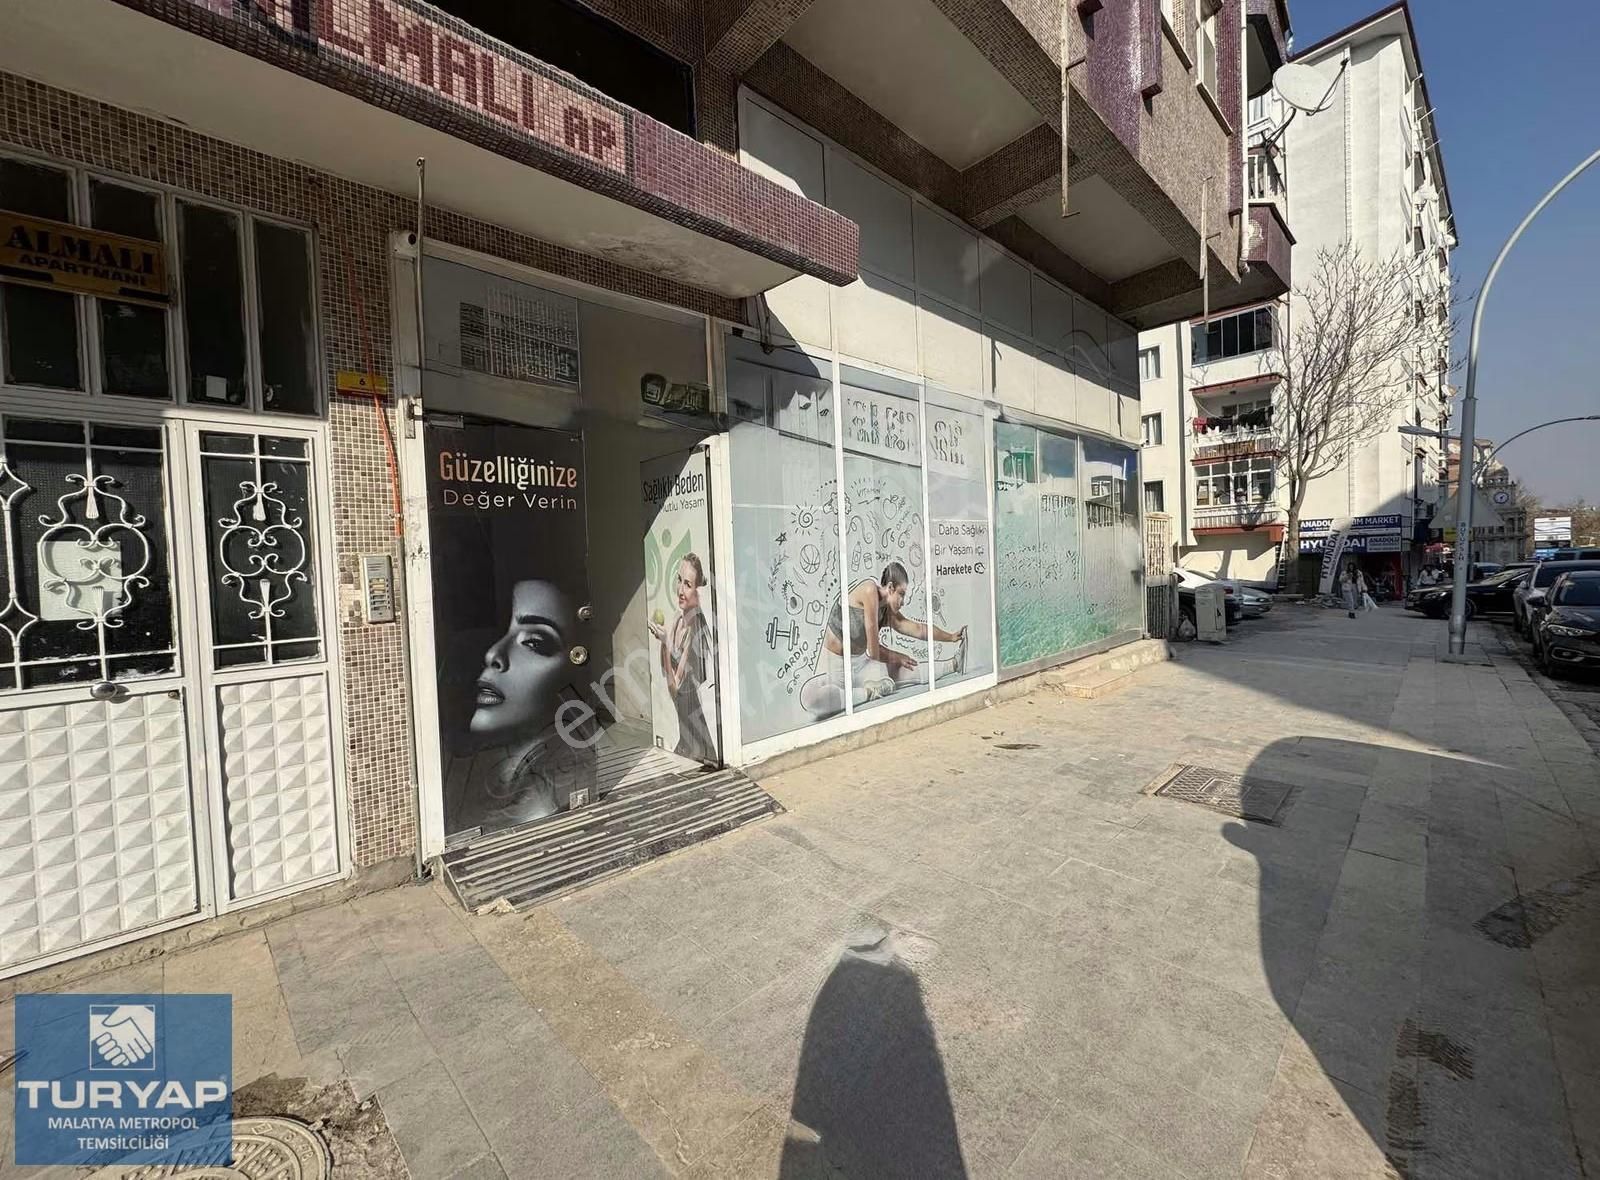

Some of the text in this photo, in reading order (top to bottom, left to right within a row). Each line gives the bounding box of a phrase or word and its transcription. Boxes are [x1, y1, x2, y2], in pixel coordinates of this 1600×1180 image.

[260, 0, 617, 155] LMALI AP
[4, 225, 154, 274] ALMALI
[439, 451, 577, 490] Güzelliğinize
[674, 470, 704, 496] Beden
[443, 490, 577, 510] Değer Verin
[680, 498, 705, 511] Yaşam
[938, 523, 959, 535] Daha
[1365, 515, 1399, 525] MARKET
[935, 544, 946, 555] Bir
[948, 543, 973, 556] Yaşam
[1300, 538, 1365, 549] HYUDAI
[1320, 529, 1341, 579] HYUNDAI
[936, 563, 972, 576] Harekete
[777, 641, 808, 679] CARDIO
